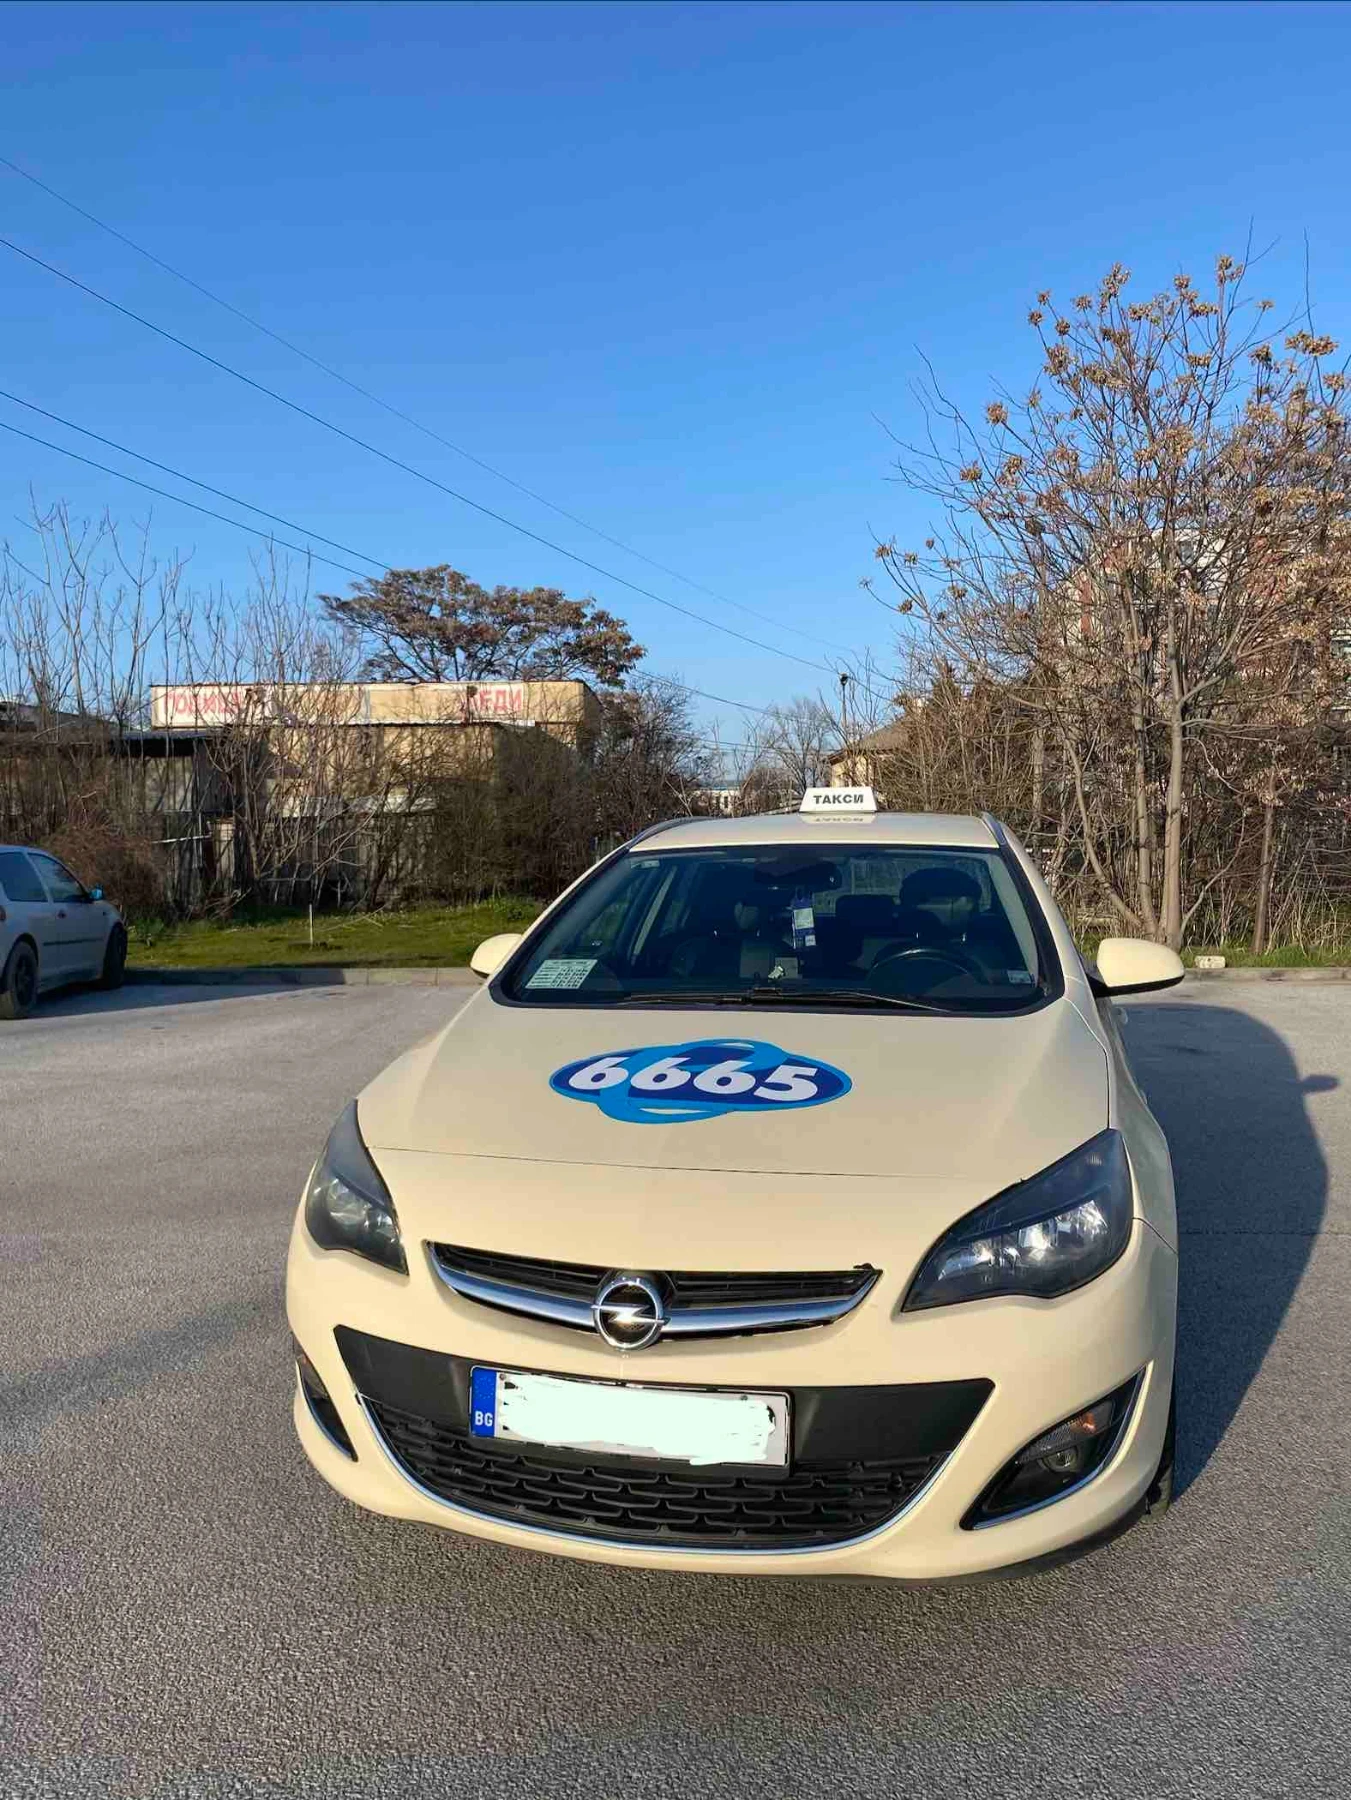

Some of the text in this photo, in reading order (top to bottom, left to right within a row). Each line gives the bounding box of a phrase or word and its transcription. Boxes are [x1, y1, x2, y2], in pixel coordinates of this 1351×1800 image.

[813, 794, 864, 804] ТАКСИ
[568, 1056, 818, 1101] 6665
[474, 1410, 493, 1427] BG
